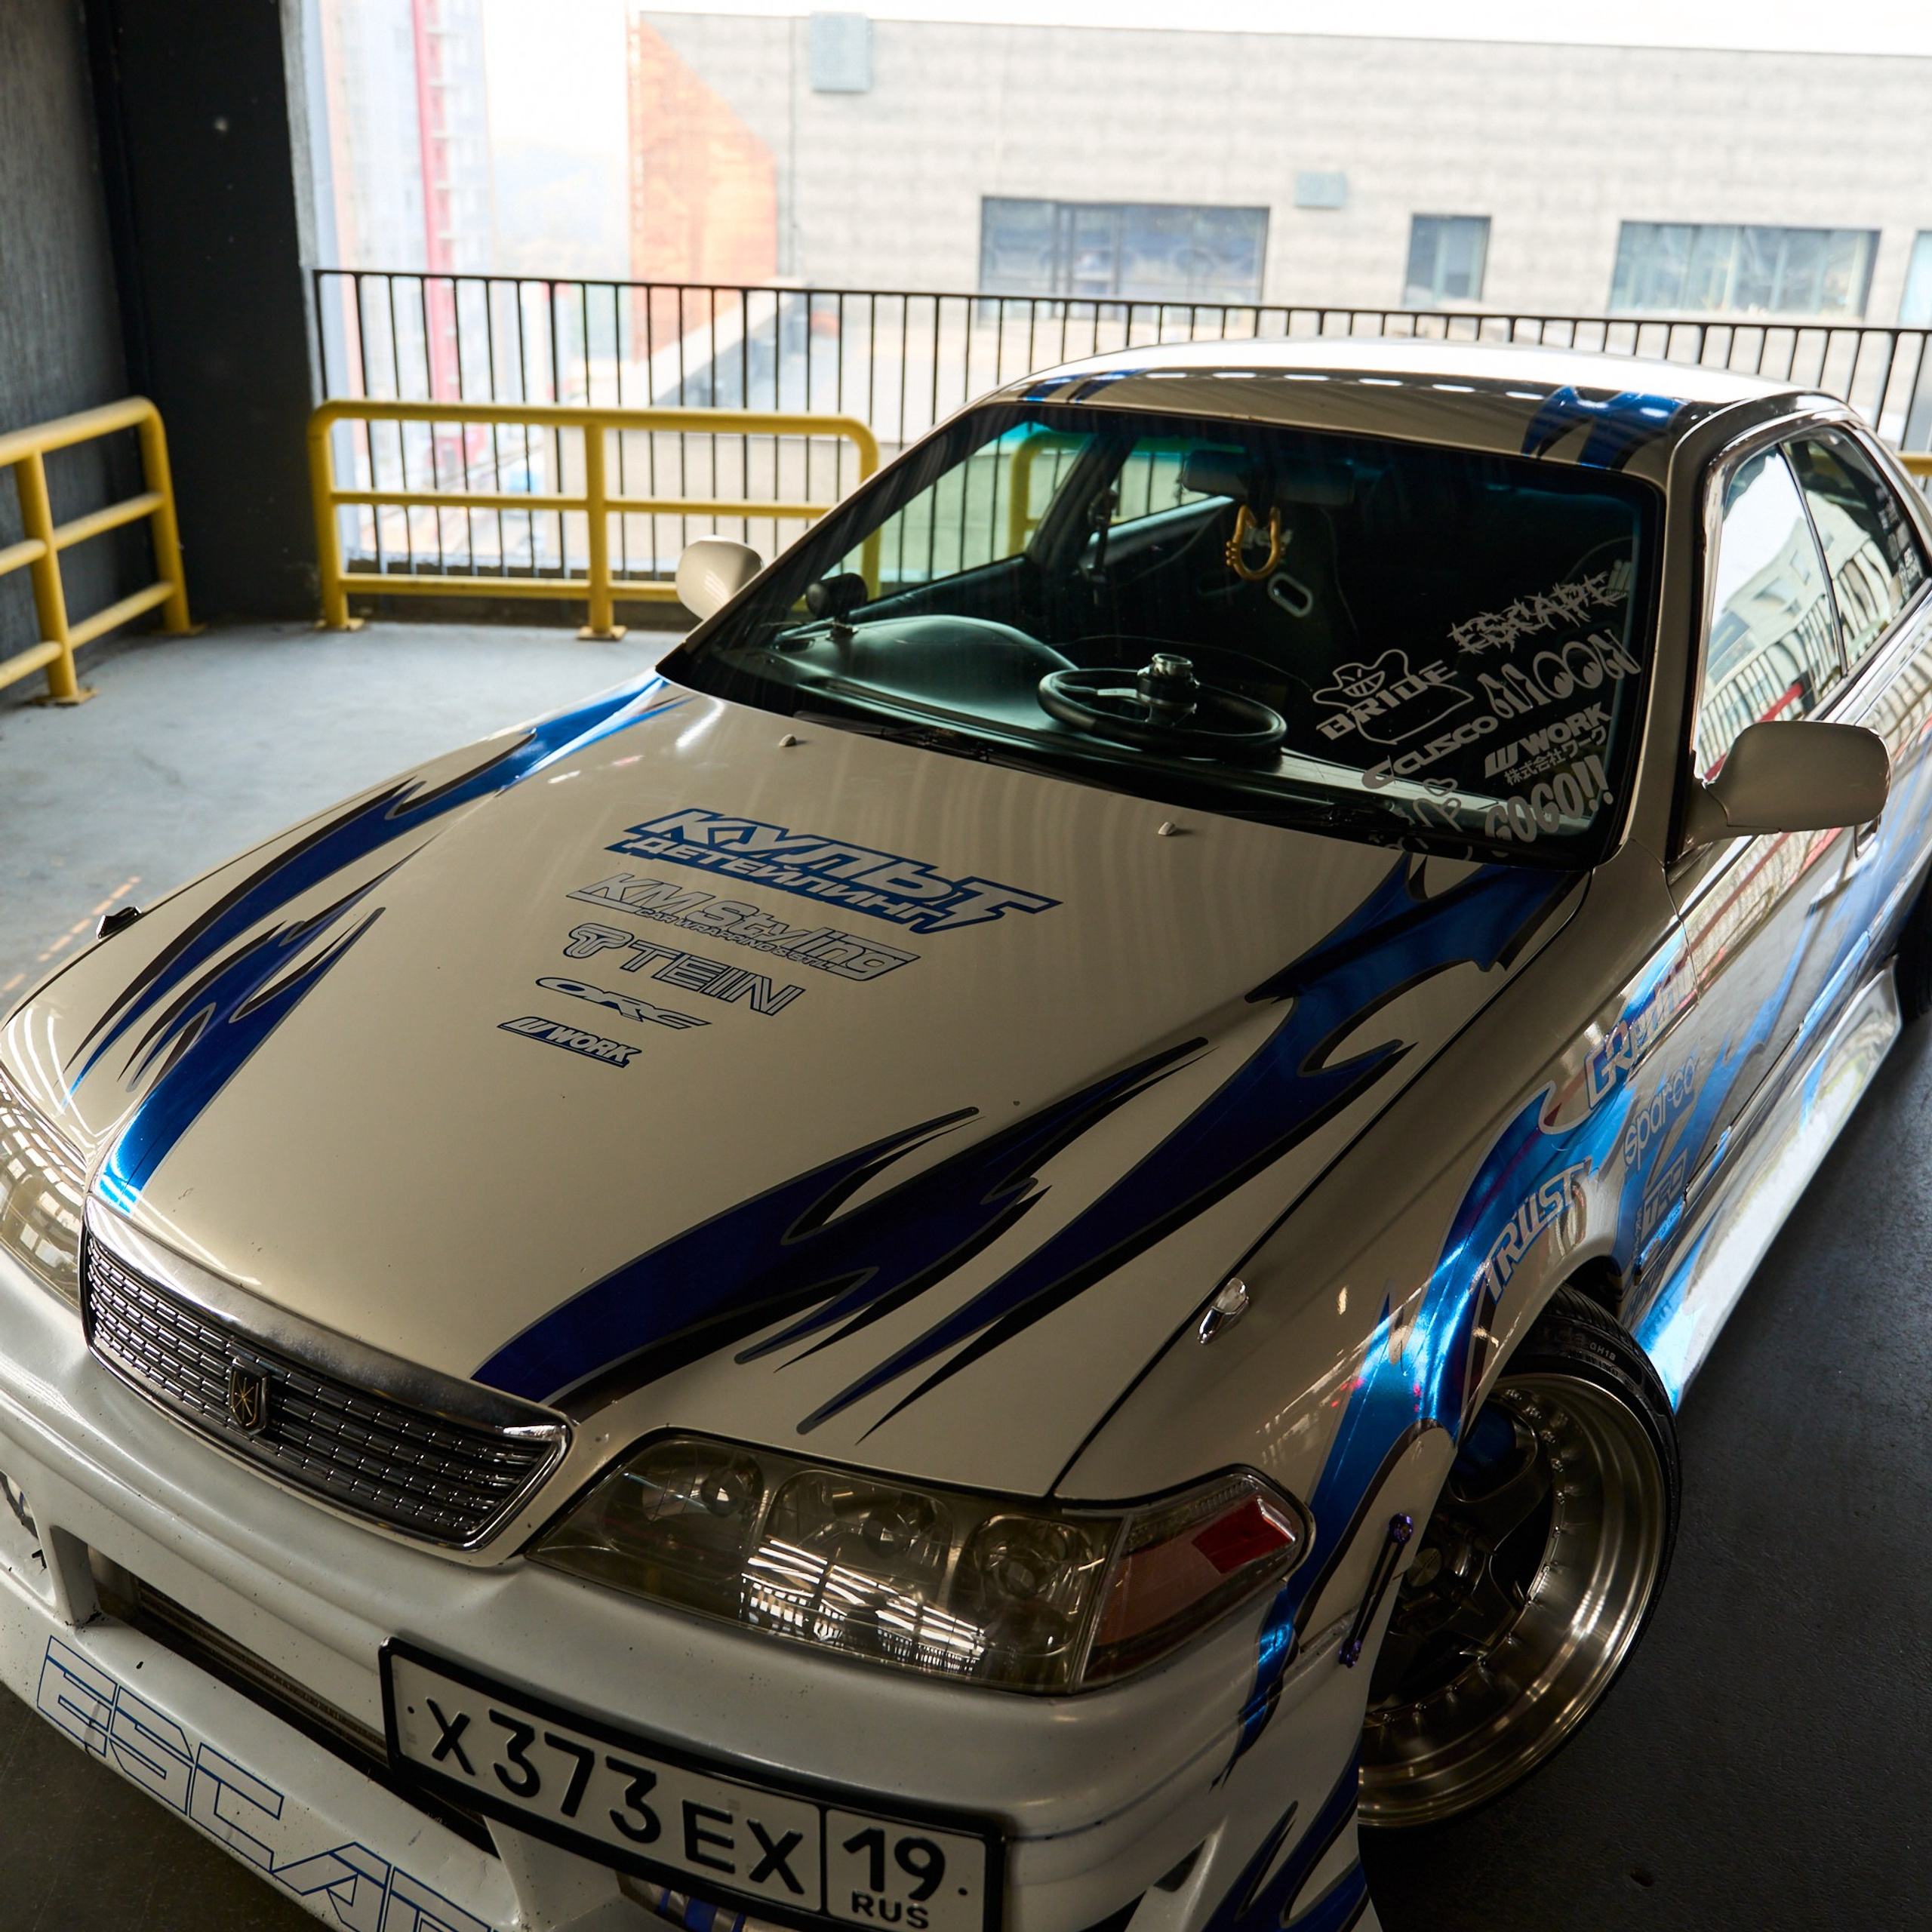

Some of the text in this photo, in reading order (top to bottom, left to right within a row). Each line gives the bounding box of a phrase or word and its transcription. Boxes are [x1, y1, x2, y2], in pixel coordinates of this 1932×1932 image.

[1316, 660, 1458, 740] BRIDE
[1477, 629, 1641, 719] MOON
[1392, 715, 1499, 775] CUSCO
[1504, 723, 1607, 786] 株式会社ワーク
[635, 908, 679, 924] CAR
[674, 917, 777, 952] WRAPPING
[617, 938, 805, 1016] TEIN
[1623, 1057, 1697, 1172] sparco
[1467, 1162, 1584, 1302] TRUST
[841, 1826, 946, 1902] 19
[851, 1890, 930, 1930] RUS
